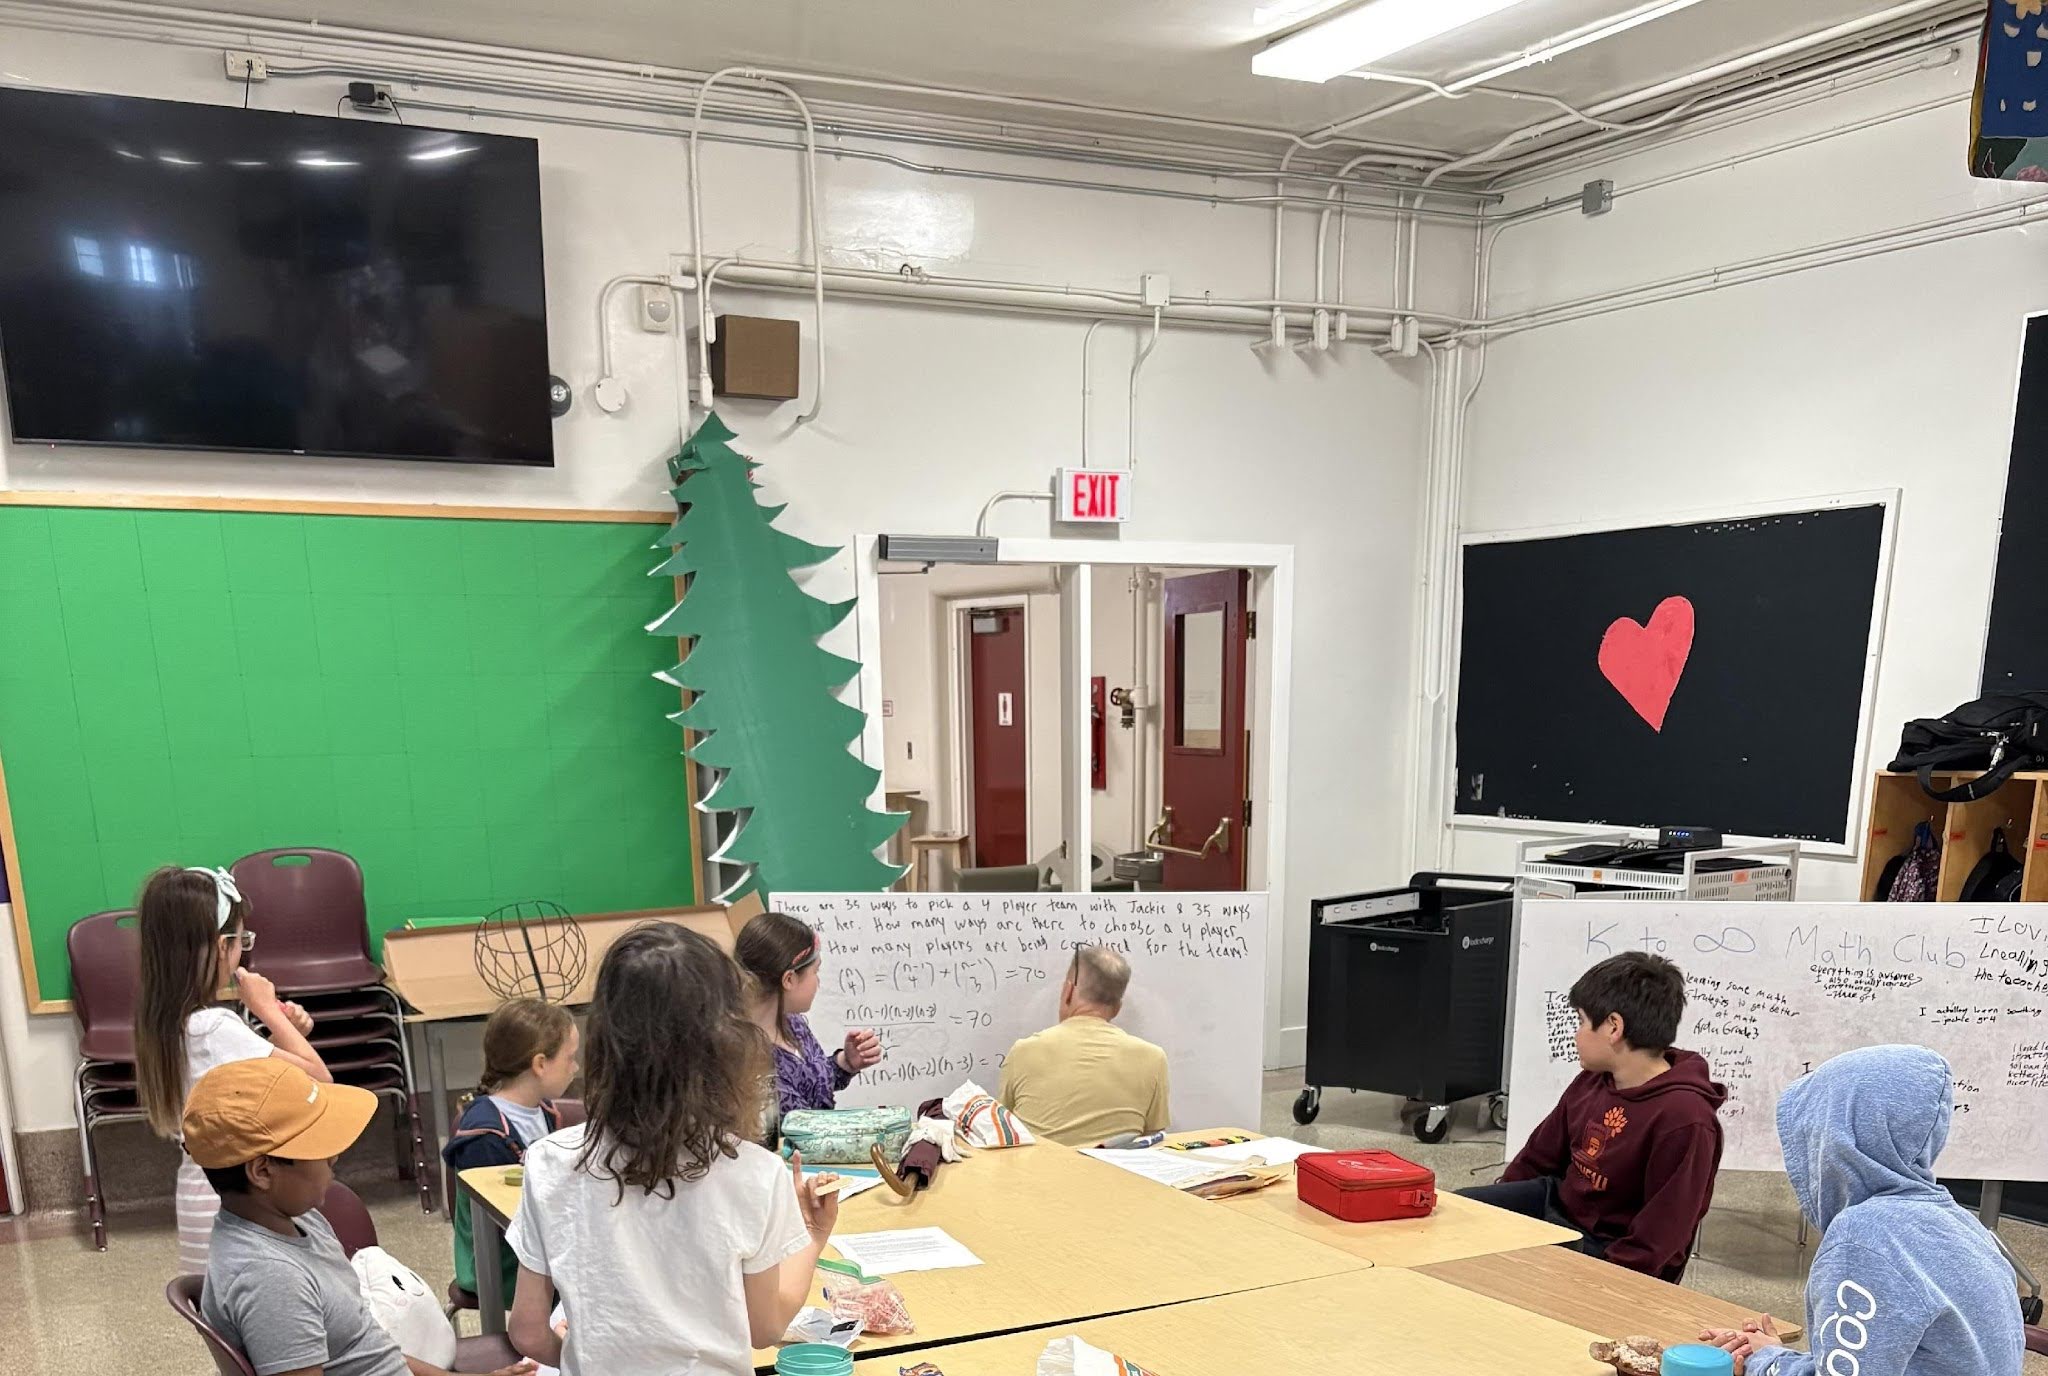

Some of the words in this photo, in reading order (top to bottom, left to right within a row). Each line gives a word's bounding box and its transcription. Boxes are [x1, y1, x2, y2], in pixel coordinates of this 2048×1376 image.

[1073, 474, 1119, 517] EXIT
[775, 901, 810, 912] There
[845, 900, 860, 911] 35
[870, 902, 897, 916] ways
[905, 898, 918, 909] to
[929, 899, 953, 911] pick
[963, 901, 971, 910] a
[982, 899, 990, 911] 4
[1003, 900, 1037, 916] player
[1047, 899, 1077, 911] team
[1090, 898, 1117, 912] with
[1127, 901, 1166, 914] Jackie
[1192, 903, 1210, 917] 35
[1223, 904, 1250, 922] ways
[835, 916, 861, 931] her.
[873, 917, 900, 932] How
[911, 917, 946, 934] many
[954, 918, 987, 935] ways
[996, 922, 1022, 931] are
[1032, 917, 1065, 931] there
[1080, 914, 1095, 931] to
[1105, 917, 1155, 935] choose
[1164, 924, 1173, 933] a
[1182, 923, 1191, 939] 4
[1201, 923, 1237, 944] player
[828, 940, 859, 955] How
[871, 943, 911, 957] many
[925, 938, 973, 956] players
[985, 941, 1008, 952] are
[1017, 936, 1048, 952] being
[1146, 938, 1167, 956] for
[1178, 941, 1200, 958] the
[1206, 937, 1248, 959] team?
[1587, 922, 1619, 954] K
[1640, 927, 1667, 952] to
[1785, 925, 1873, 966] Math
[1893, 933, 1966, 969] Club
[1974, 967, 1993, 982] the
[1686, 972, 1721, 991] learning
[1726, 981, 1749, 995] some
[1756, 990, 1787, 1005] math
[1750, 1002, 1766, 1012] get
[1919, 1007, 1927, 1017] I
[1802, 1062, 1813, 1075] I
